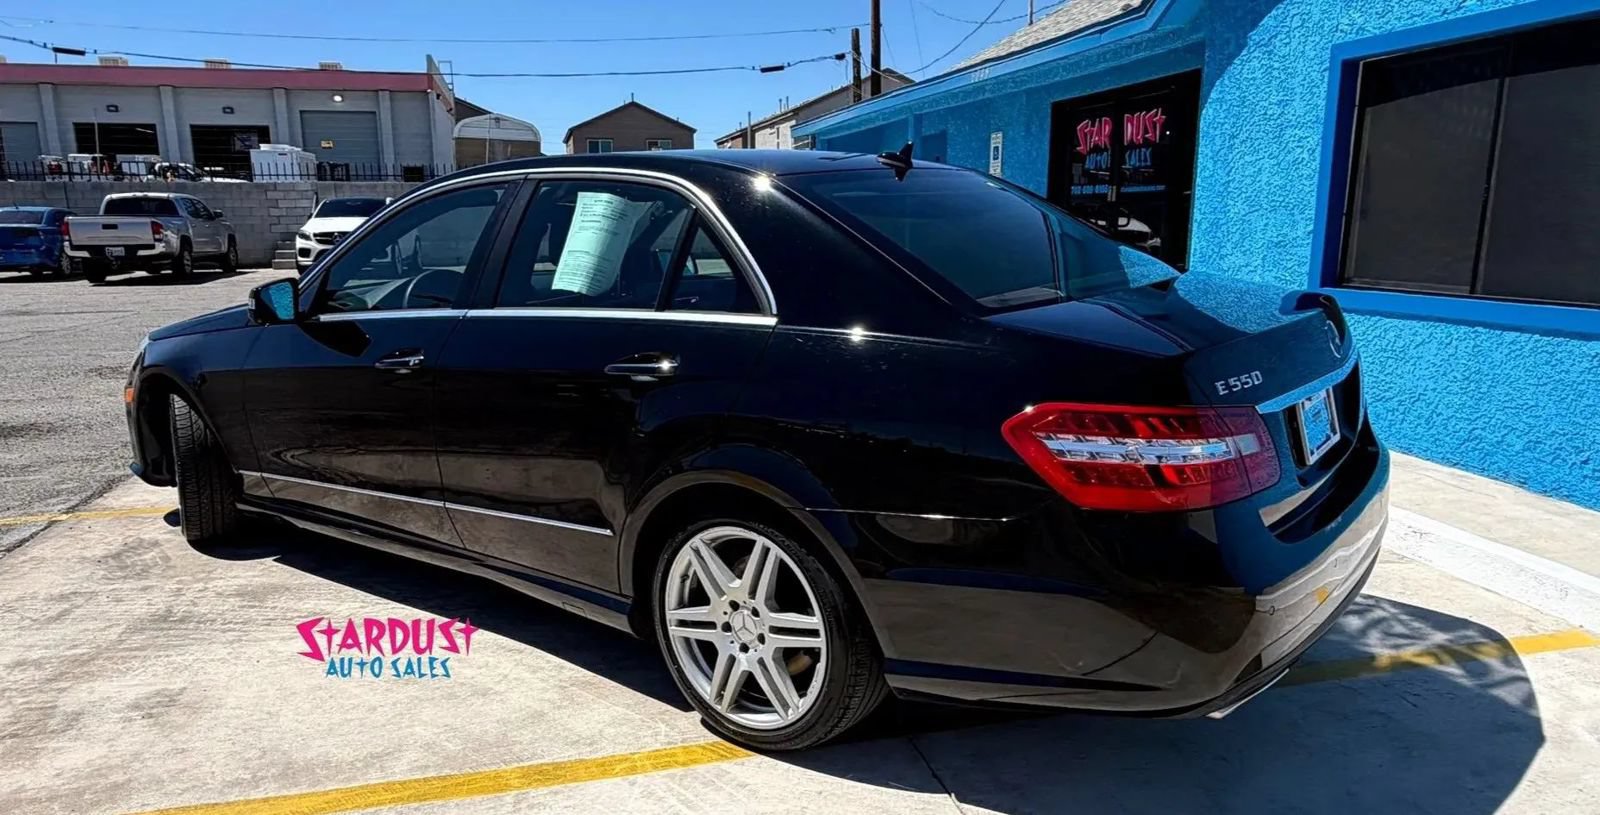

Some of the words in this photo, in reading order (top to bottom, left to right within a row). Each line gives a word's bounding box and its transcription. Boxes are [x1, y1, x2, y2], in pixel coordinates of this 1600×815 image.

[1076, 117, 1113, 154] STAR
[1124, 108, 1166, 145] DUST
[1084, 152, 1111, 169] AUTO
[1125, 147, 1153, 168] SALES
